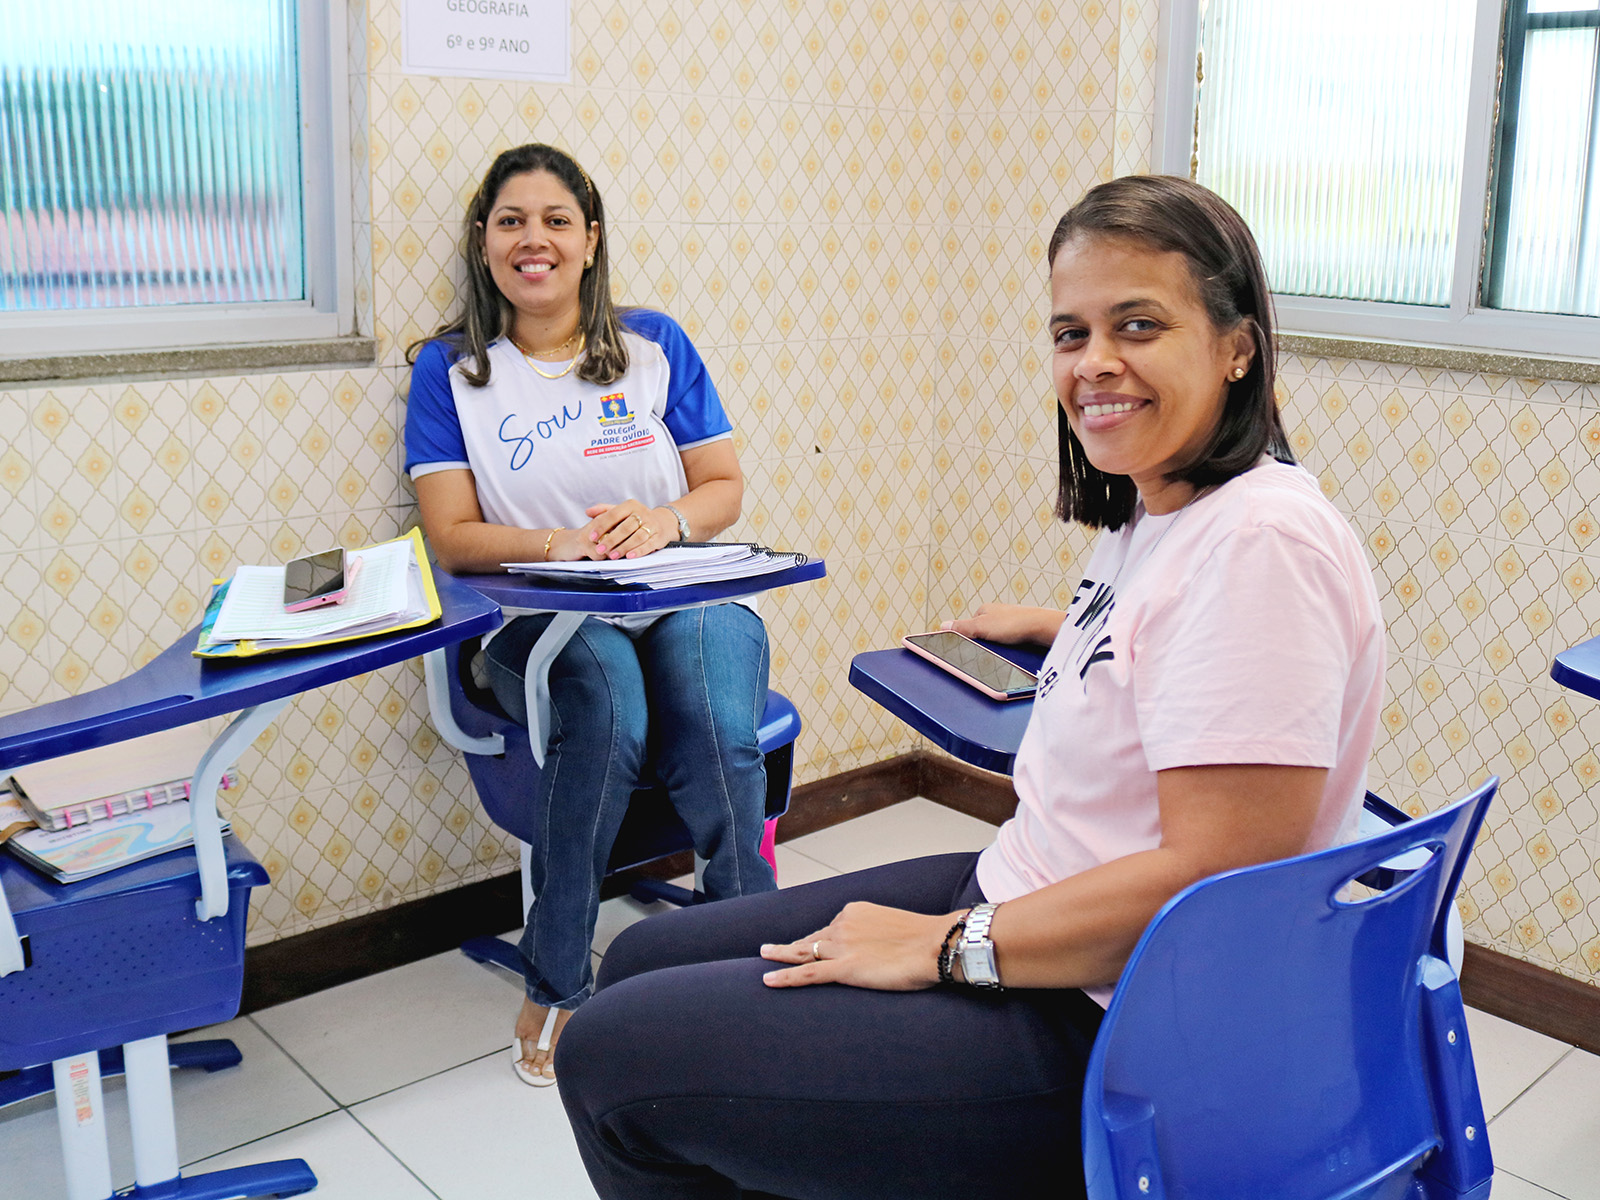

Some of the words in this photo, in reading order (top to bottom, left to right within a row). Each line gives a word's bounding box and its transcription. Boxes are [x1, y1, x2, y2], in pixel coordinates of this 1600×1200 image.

[447, 0, 529, 17] GEOGRAFIA
[446, 34, 462, 49] 6º
[466, 39, 475, 50] e
[479, 37, 495, 51] 9º
[498, 39, 530, 54] ANO
[498, 400, 582, 471] Sou
[591, 436, 620, 447] PADRE
[622, 428, 650, 442] OVÍDIO
[602, 424, 636, 436] COLÉGIO
